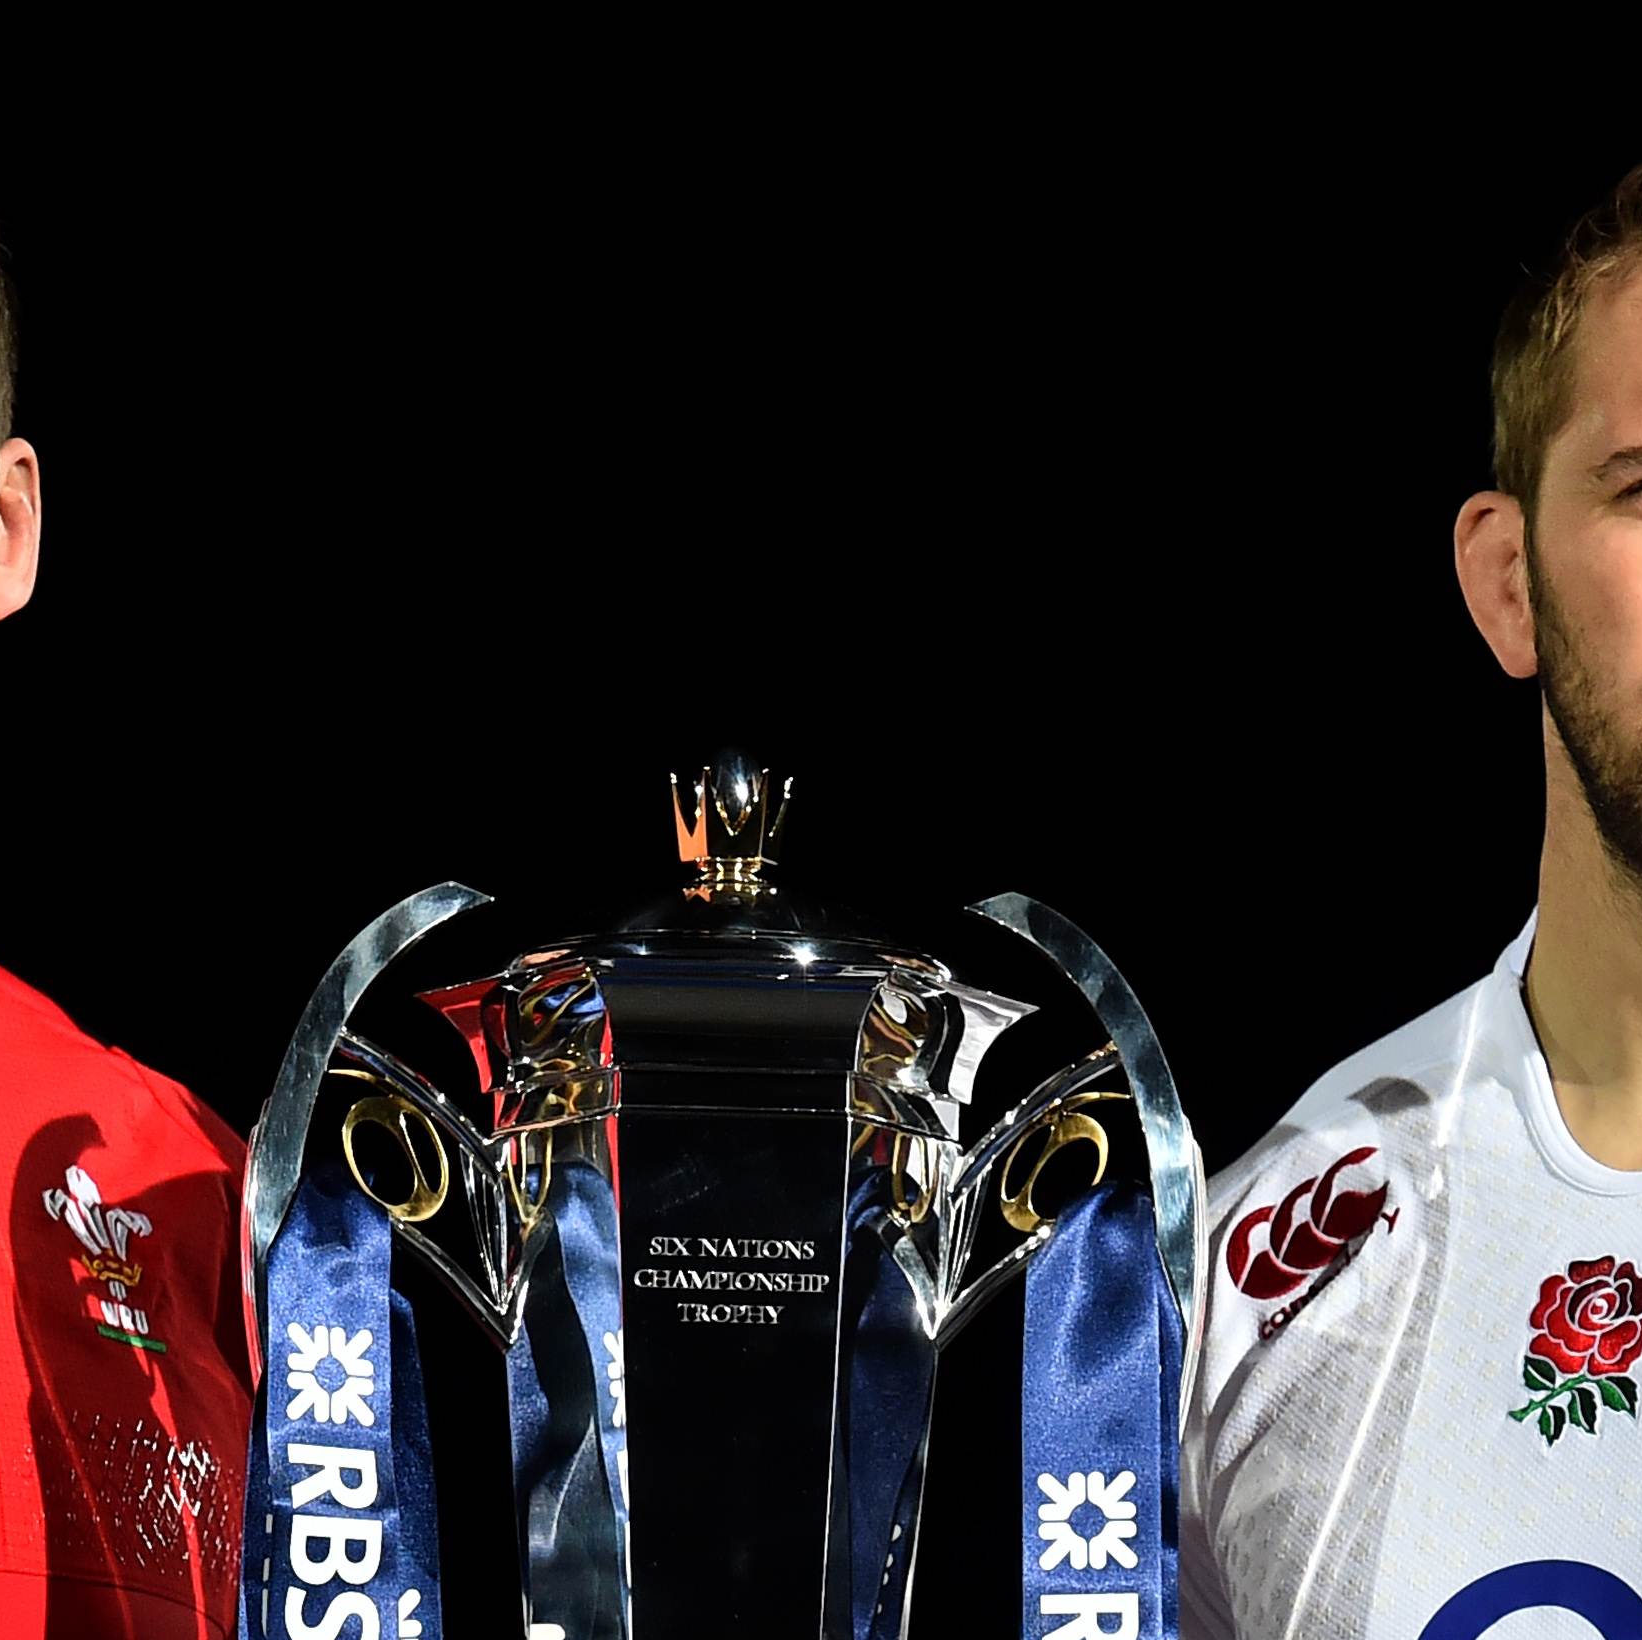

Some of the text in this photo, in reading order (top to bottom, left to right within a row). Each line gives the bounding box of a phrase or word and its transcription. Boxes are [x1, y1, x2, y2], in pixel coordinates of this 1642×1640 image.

[649, 1236, 815, 1260] SIX NATIONS
[633, 1268, 830, 1293] CHAMPIONSHIP
[100, 1300, 149, 1335] WRU
[677, 1302, 785, 1324] TROPHY
